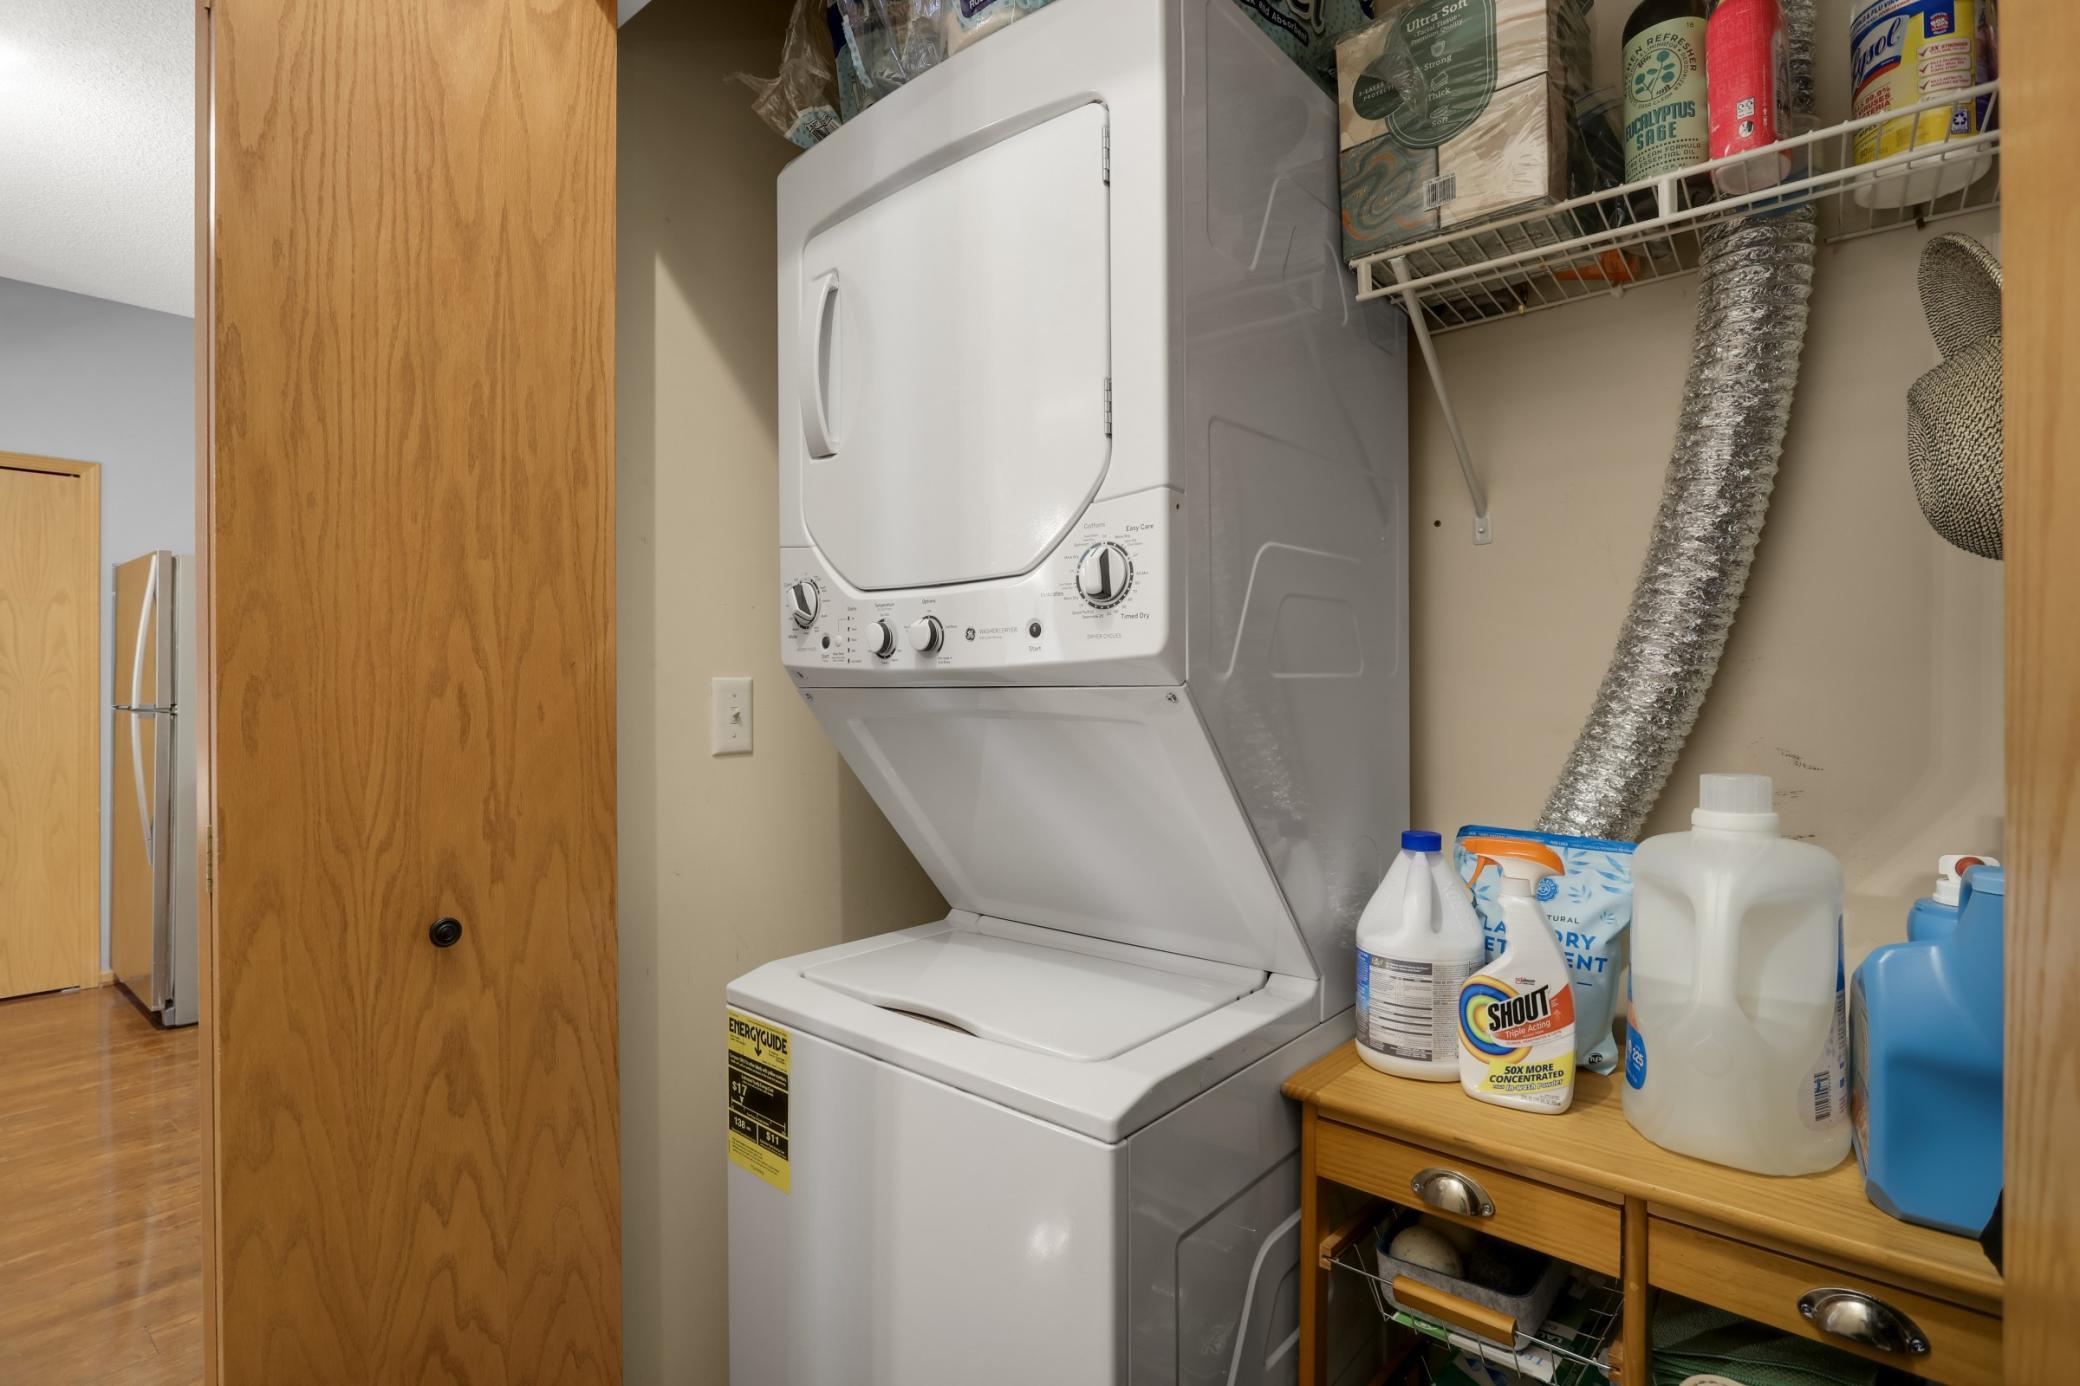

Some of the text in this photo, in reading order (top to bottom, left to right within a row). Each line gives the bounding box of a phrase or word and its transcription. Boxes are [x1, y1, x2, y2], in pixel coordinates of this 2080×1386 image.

[1406, 0, 1468, 33] Ultra Soft
[1271, 11, 1308, 42] Absorbent
[1646, 32, 1698, 72] REFRESHER
[1423, 54, 1454, 71] Strong
[1625, 100, 1697, 143] EUCALYPTUS
[1636, 120, 1677, 151] SAGE
[1138, 612, 1150, 620] Dry
[1546, 914, 1580, 924] TURAL
[1487, 984, 1549, 1031] SHOUT
[1505, 1027, 1526, 1039] Triple
[1527, 1020, 1551, 1032] Acting
[1489, 1070, 1564, 1084] CONCENTRATED
[1504, 1063, 1554, 1075] 50X MORE
[731, 1080, 748, 1097] $17
